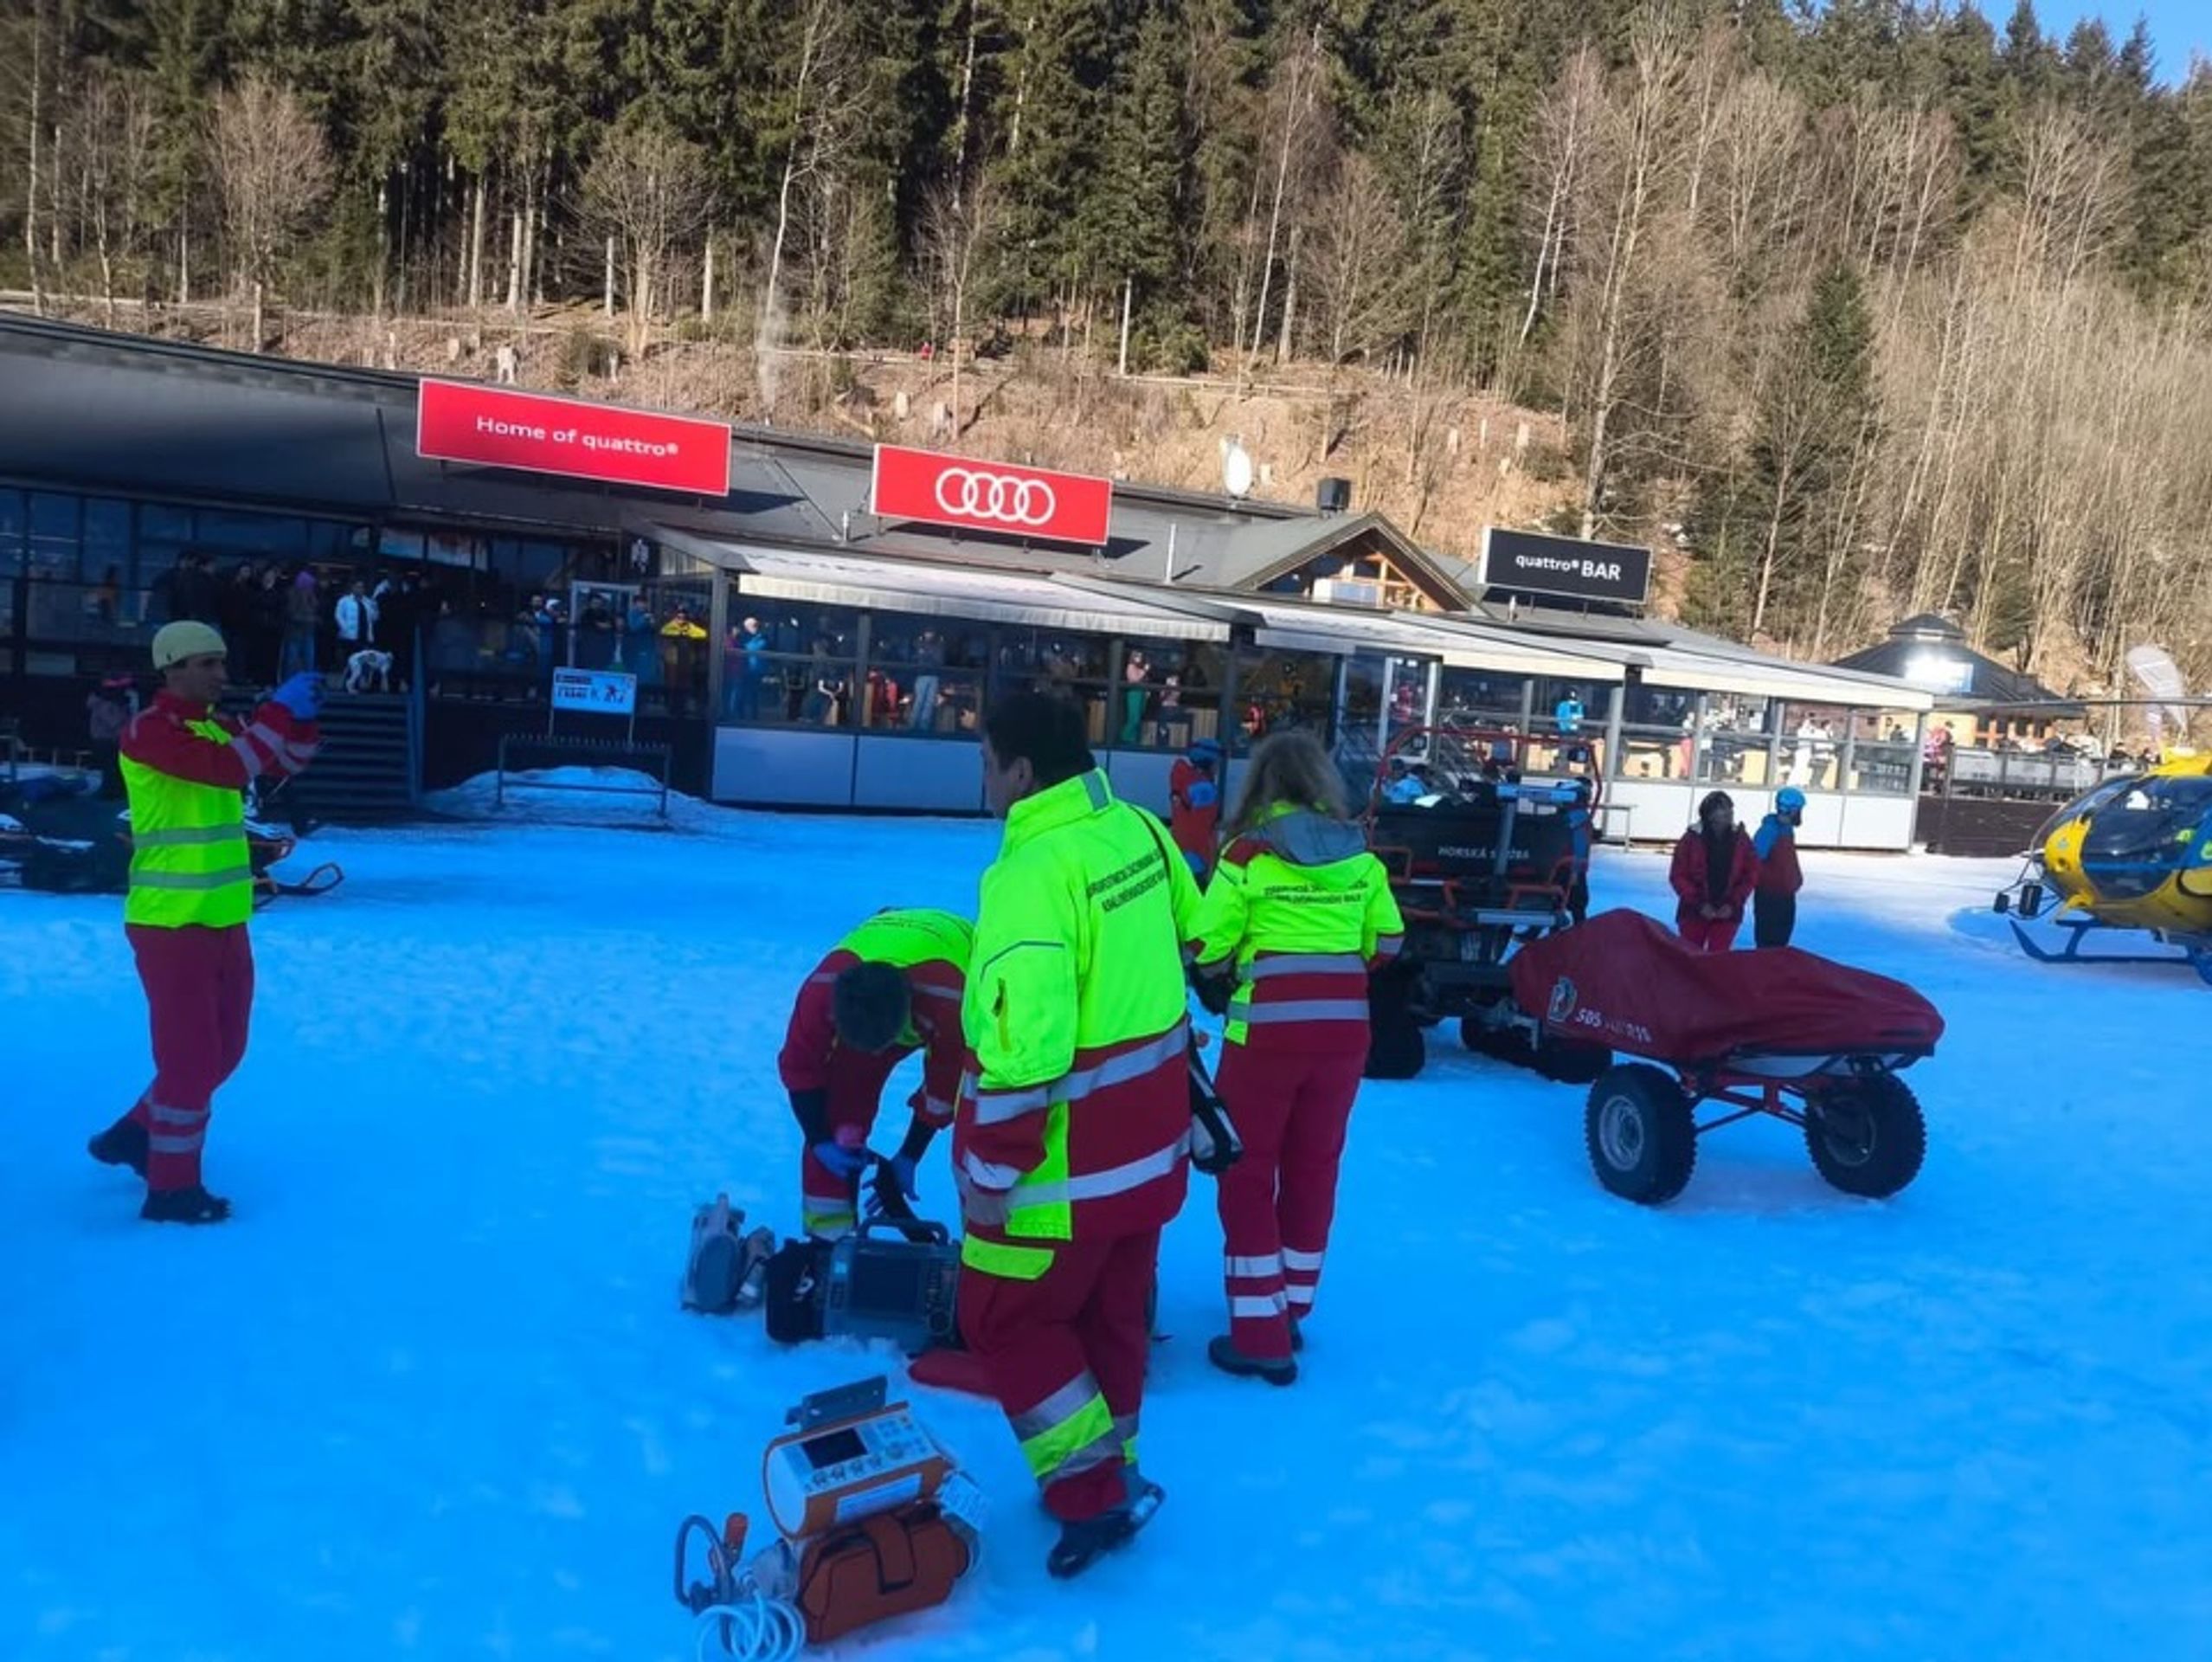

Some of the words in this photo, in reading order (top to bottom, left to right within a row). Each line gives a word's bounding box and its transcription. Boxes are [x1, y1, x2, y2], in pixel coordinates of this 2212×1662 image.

[476, 416, 546, 440] Home
[552, 428, 578, 444] of
[1582, 560, 1621, 581] BAR
